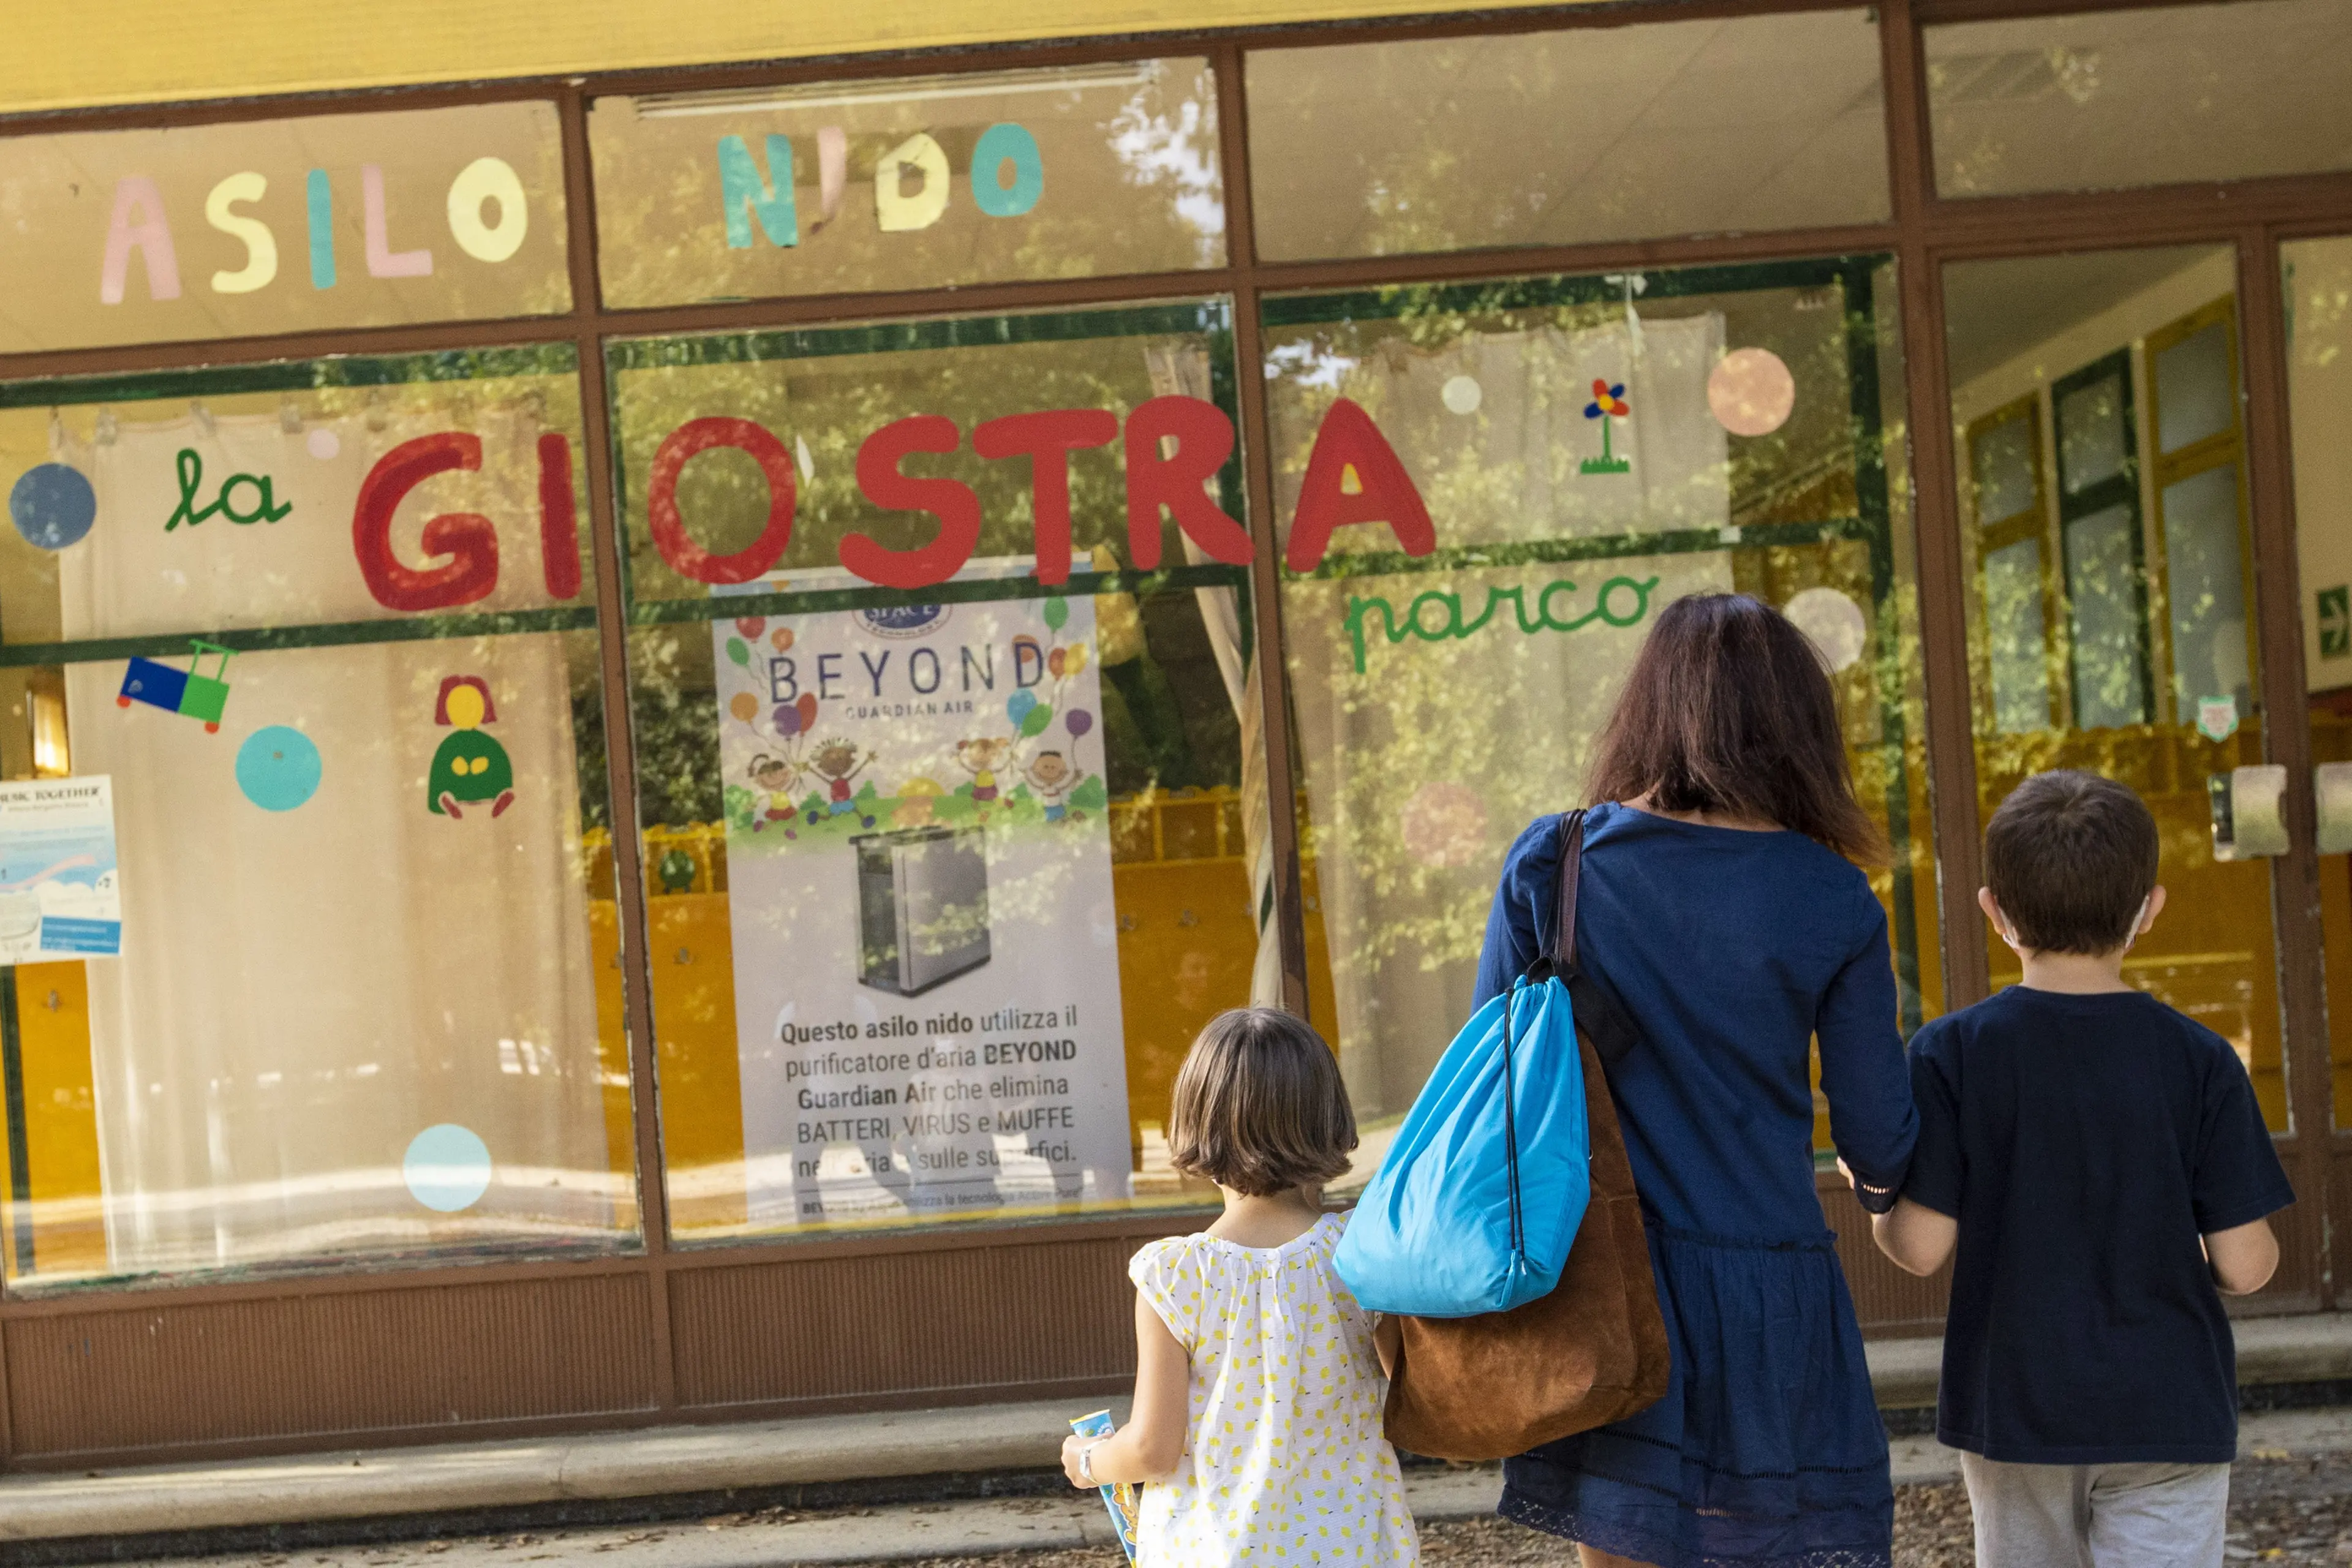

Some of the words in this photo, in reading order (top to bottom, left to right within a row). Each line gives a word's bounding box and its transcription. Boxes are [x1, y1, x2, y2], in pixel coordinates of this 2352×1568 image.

[101, 157, 529, 304] ASILO
[164, 448, 293, 532] la
[352, 394, 1437, 612] GIOSTRA
[1343, 576, 1660, 674] parco
[769, 641, 1043, 704] BEYOND
[845, 702, 937, 720] GUARDIAN
[944, 700, 973, 714] AIR
[780, 1021, 858, 1046] Questo
[865, 1014, 919, 1039] asilo
[925, 1012, 974, 1035] nido
[981, 1008, 1058, 1032] utilizza
[1066, 1004, 1077, 1027] il
[786, 1051, 910, 1082] purificatore
[918, 1046, 977, 1069] d'aria
[984, 1039, 1077, 1065] BEYOND
[798, 1084, 897, 1110] Guardian
[905, 1081, 936, 1104] Air
[944, 1078, 982, 1101] che
[989, 1074, 1069, 1098] elimina
[797, 1116, 898, 1144] BATTERI,
[902, 1112, 971, 1137] VIRUS
[978, 1117, 990, 1133] e
[997, 1106, 1075, 1133] MUFFE
[919, 1144, 969, 1170] sulle
